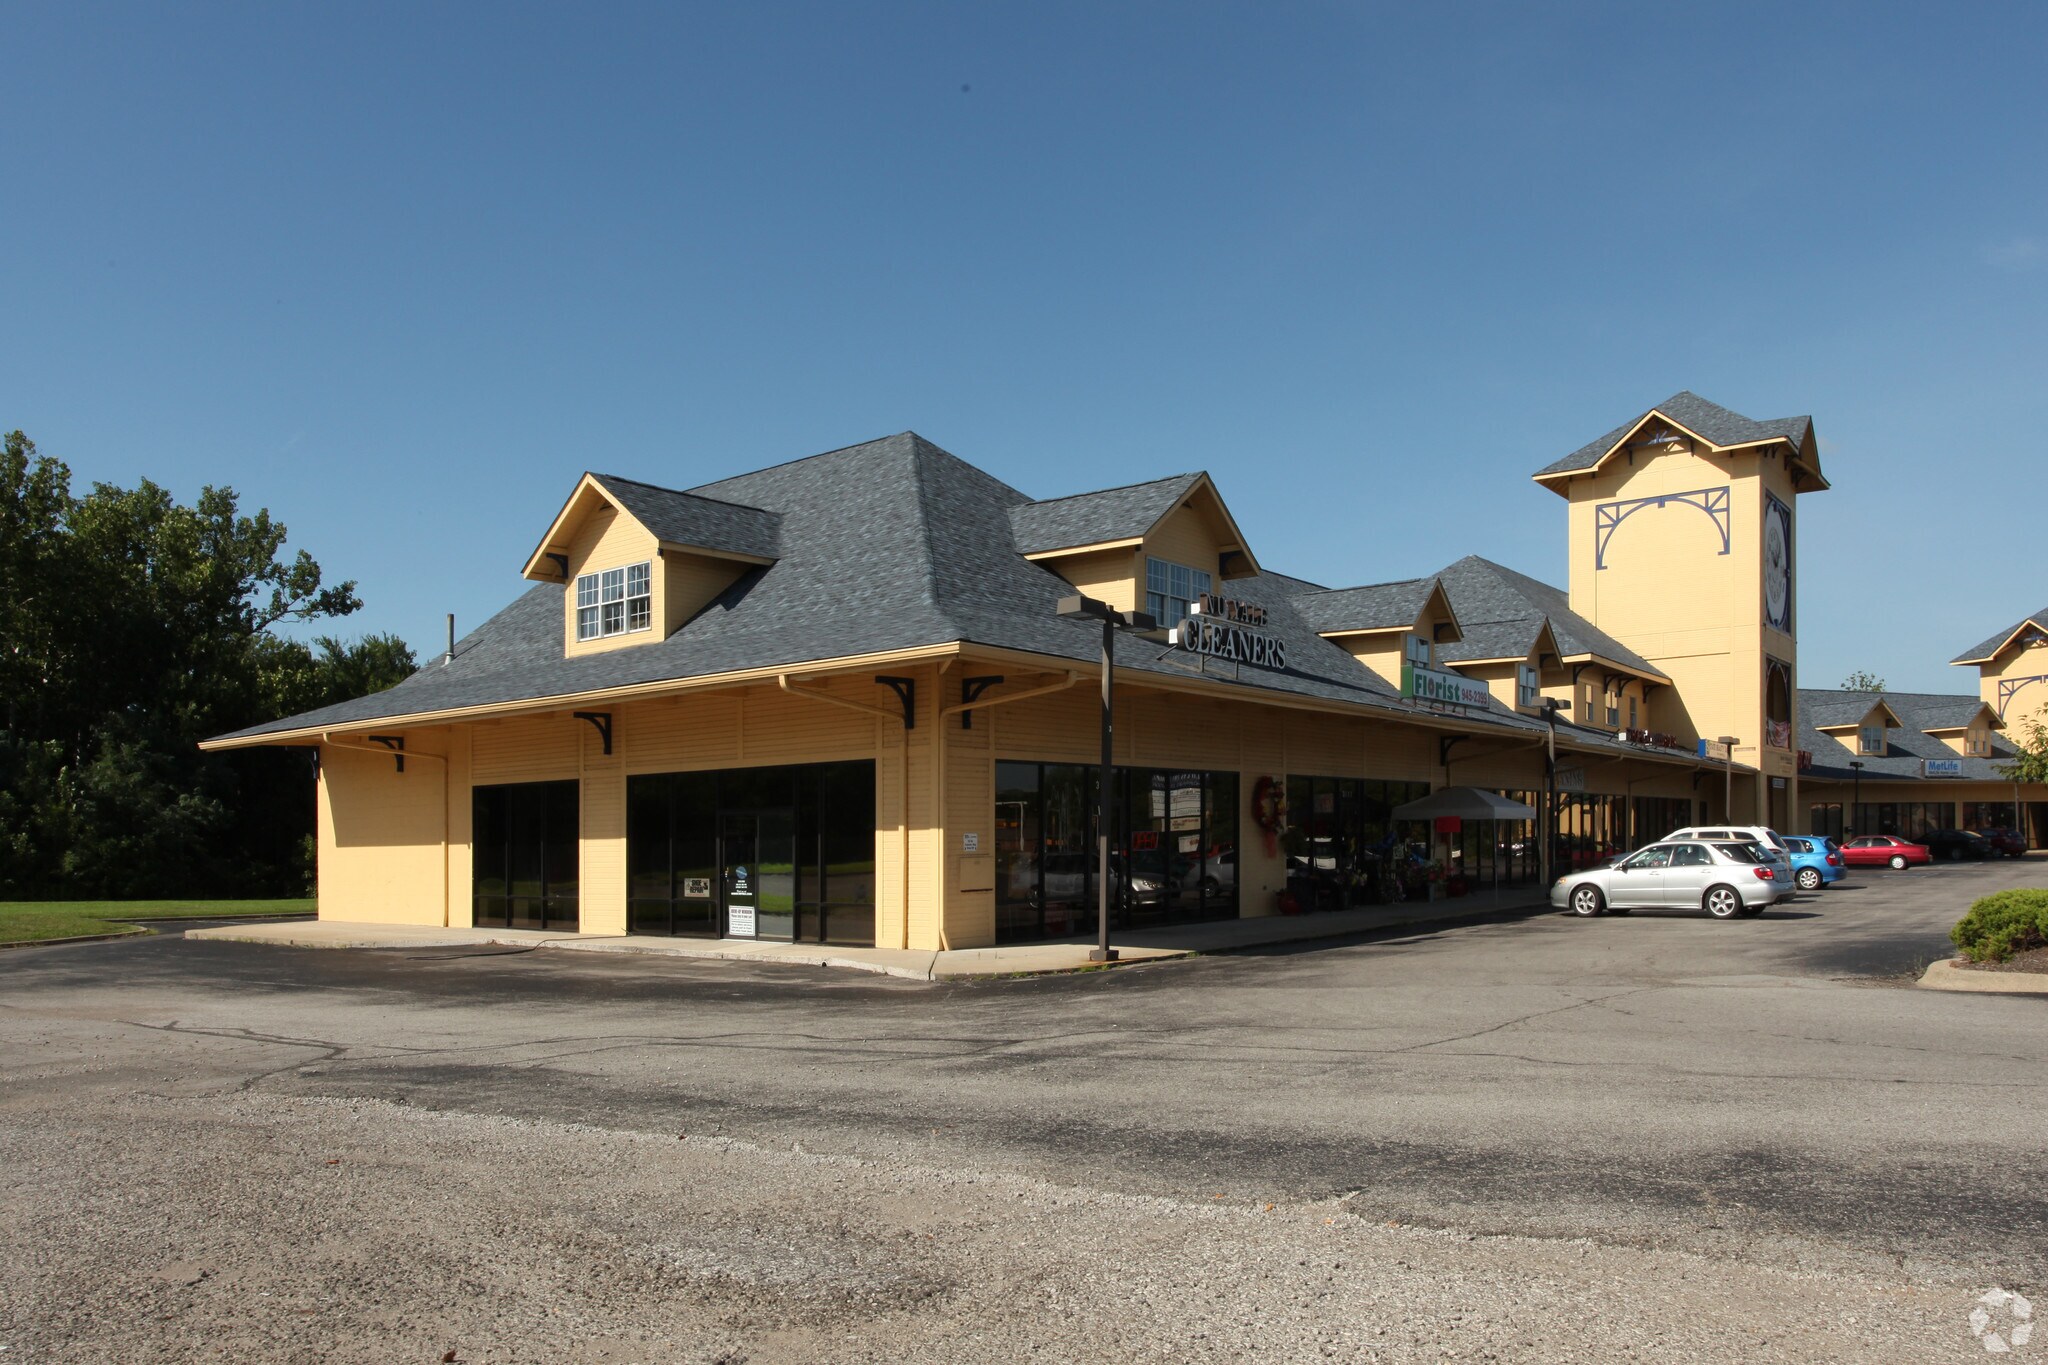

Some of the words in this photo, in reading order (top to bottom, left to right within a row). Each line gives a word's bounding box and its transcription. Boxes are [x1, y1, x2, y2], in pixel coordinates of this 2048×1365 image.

[1181, 618, 1286, 669] CLEANERS
[1415, 673, 1460, 701] Florist
[1928, 761, 1958, 770] MetLife
